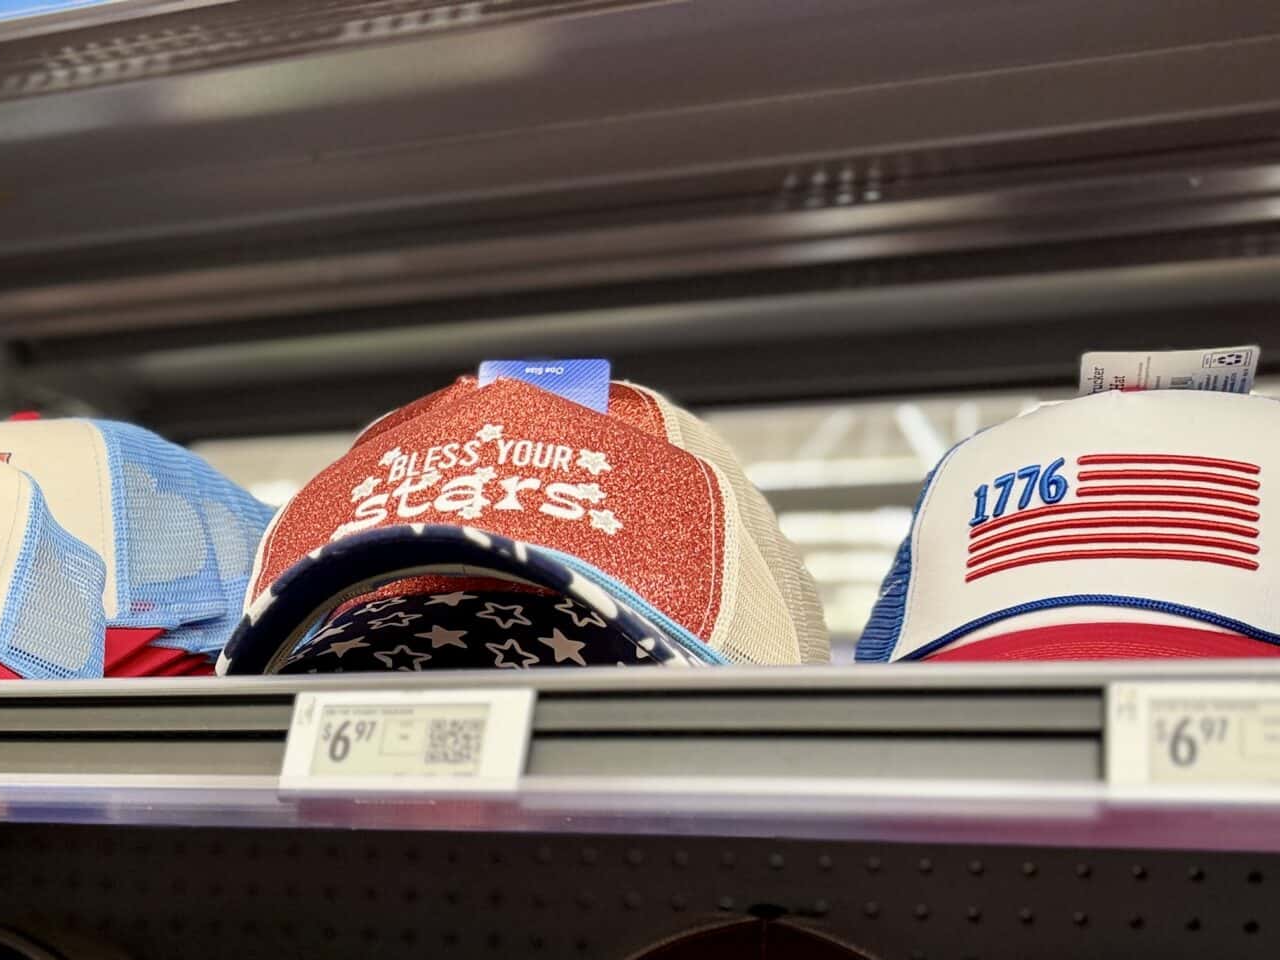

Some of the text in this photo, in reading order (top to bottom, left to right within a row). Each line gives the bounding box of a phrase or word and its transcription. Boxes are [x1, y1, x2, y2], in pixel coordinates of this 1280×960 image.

[387, 439, 571, 484] BLESS YOUR
[969, 457, 1068, 527] 1776
[338, 469, 586, 541] stars
